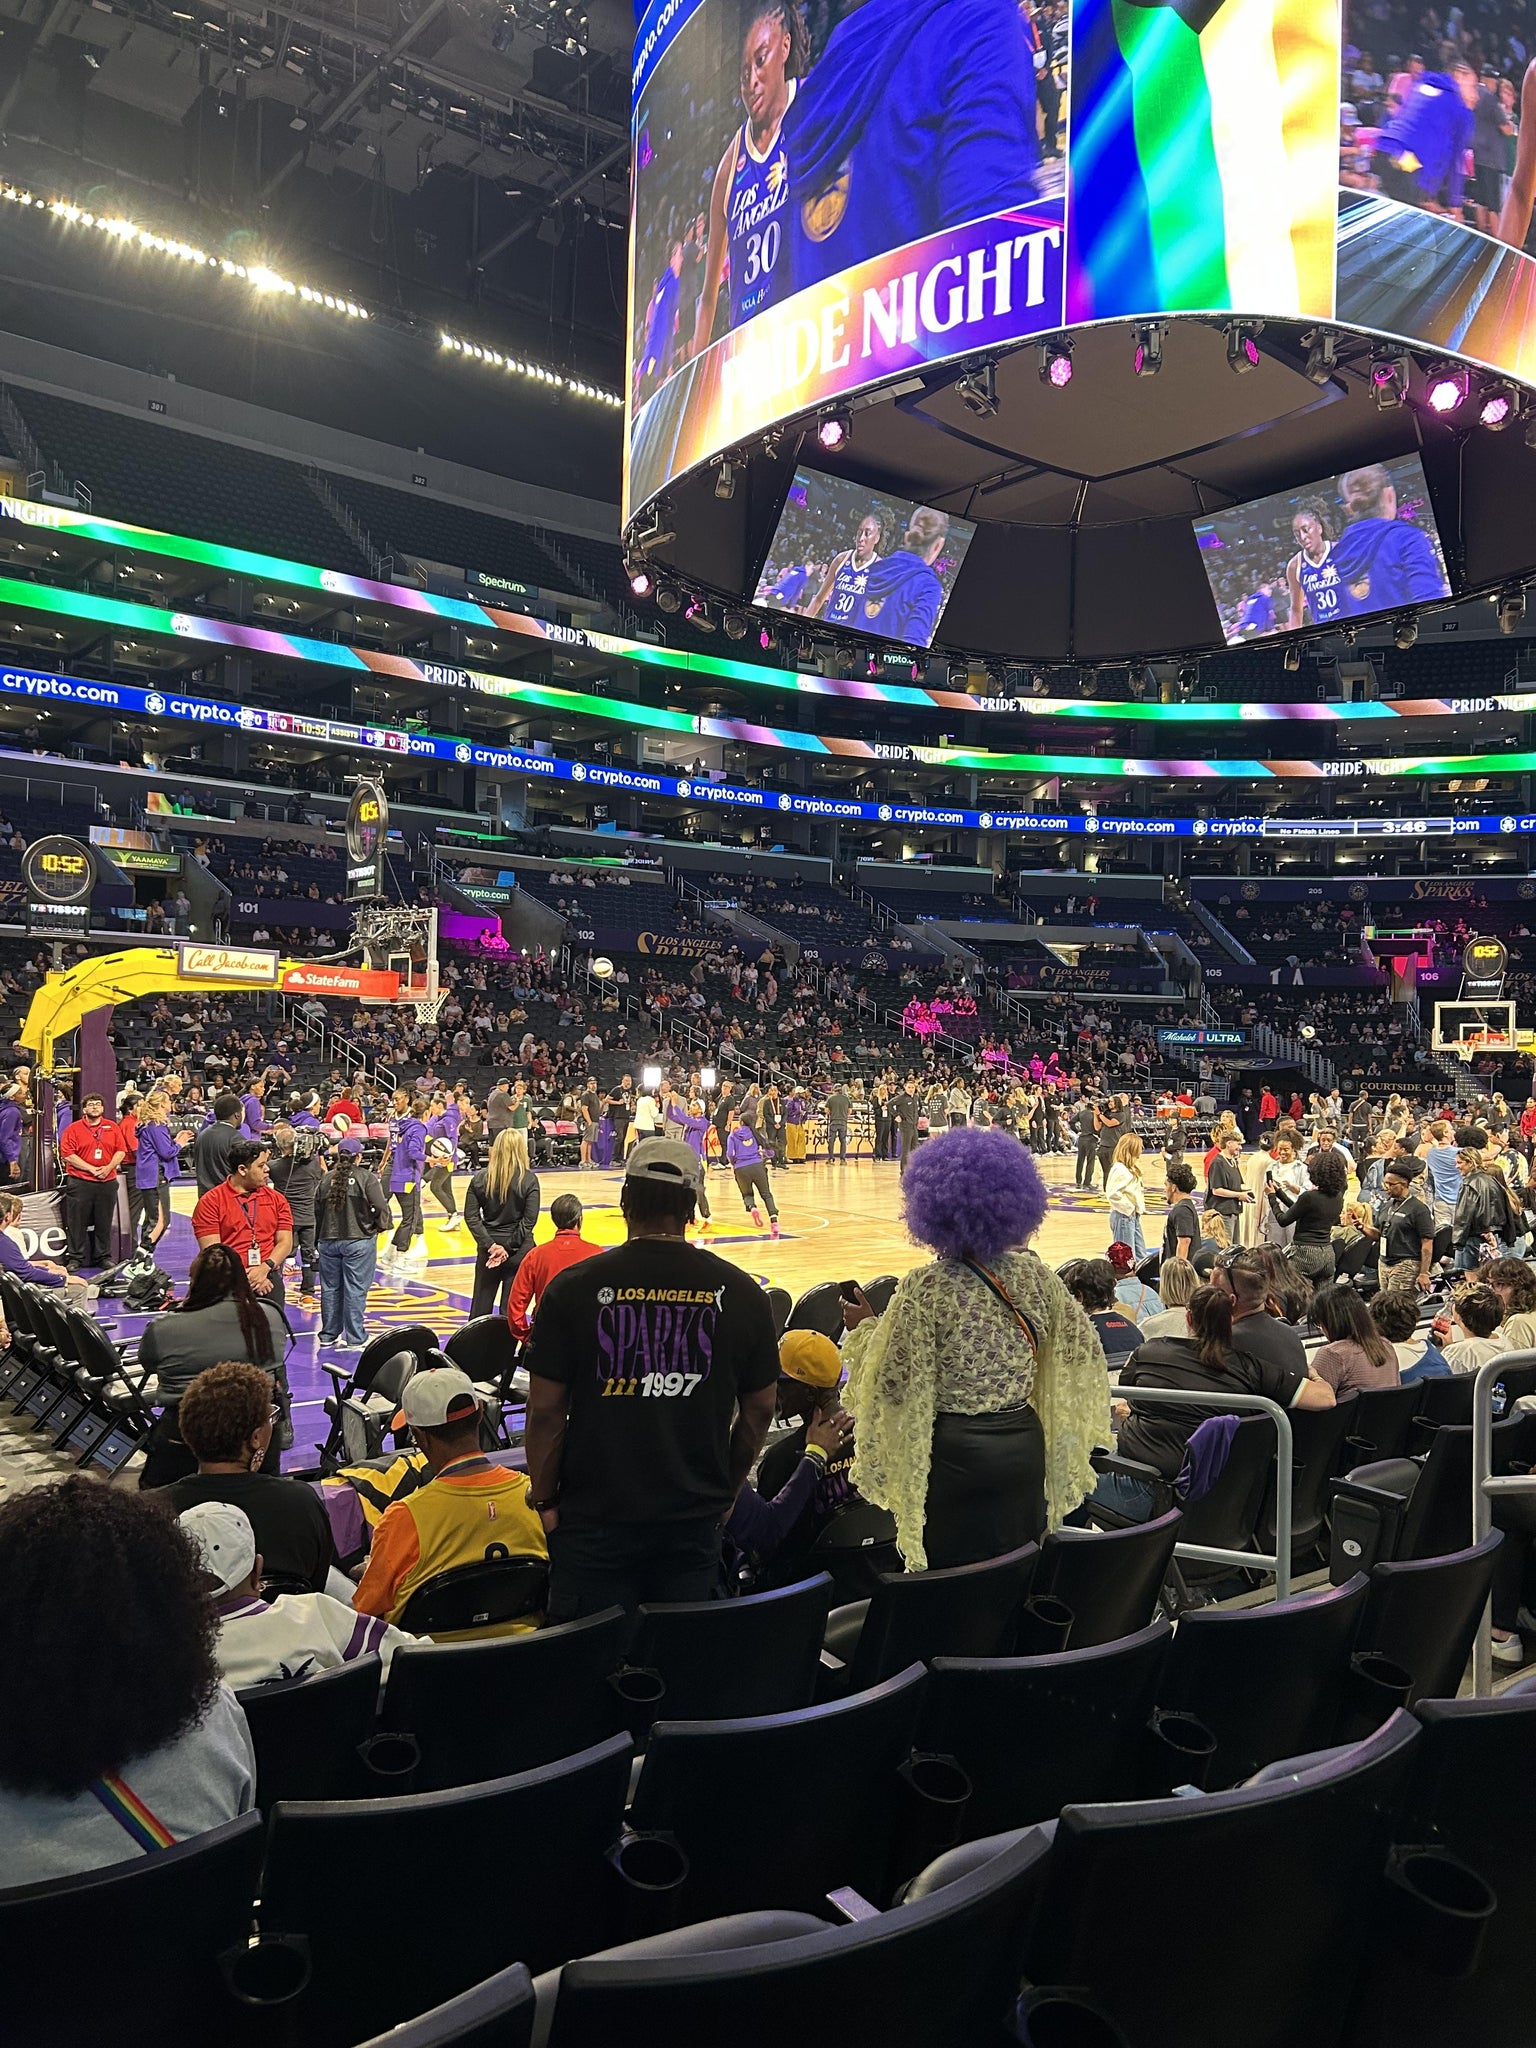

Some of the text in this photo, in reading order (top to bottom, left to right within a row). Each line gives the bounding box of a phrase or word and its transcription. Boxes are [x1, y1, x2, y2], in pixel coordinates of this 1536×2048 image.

[733, 182, 789, 241] ANGELE
[744, 220, 781, 285] 30
[861, 226, 1060, 359] NIGHT
[1, 499, 60, 528] NIGHT
[478, 573, 523, 593] Spectrum
[835, 593, 855, 613] 30
[1316, 589, 1337, 610] 30
[545, 623, 584, 645] PRIDE
[3, 673, 119, 703] crypto.com
[424, 665, 510, 695] PRIDE NIGHT
[980, 697, 1017, 711] PRIDE
[1452, 698, 1494, 712] PRIDE
[875, 744, 910, 760] PRIDE
[475, 749, 554, 773] crypto.com
[1322, 762, 1363, 775] PRIDE
[589, 770, 660, 790] crypto.com
[694, 785, 763, 804] crypto.com
[794, 799, 862, 817] crypto.com
[895, 808, 963, 824] crypto.com
[995, 814, 1068, 829] crypto.com
[1102, 820, 1175, 833] crypto.com
[1382, 821, 1427, 833] 3:46
[1409, 880, 1473, 901] SPARKS
[47, 904, 88, 916] TISSOT
[238, 903, 259, 914] 101
[578, 930, 595, 941] 102
[659, 936, 722, 949] LOS ANGELES
[188, 950, 269, 973] Call Jacob.com
[803, 951, 819, 959] 103
[1205, 969, 1222, 977] 105
[1420, 972, 1439, 981] 106
[1161, 1031, 1242, 1043] Michelob ULTRA
[1360, 1082, 1454, 1093] COURTSIDE CLUB
[616, 1288, 714, 1304] LOS ANGELES
[596, 1304, 717, 1381] SPARKS
[641, 1372, 703, 1398] 1997
